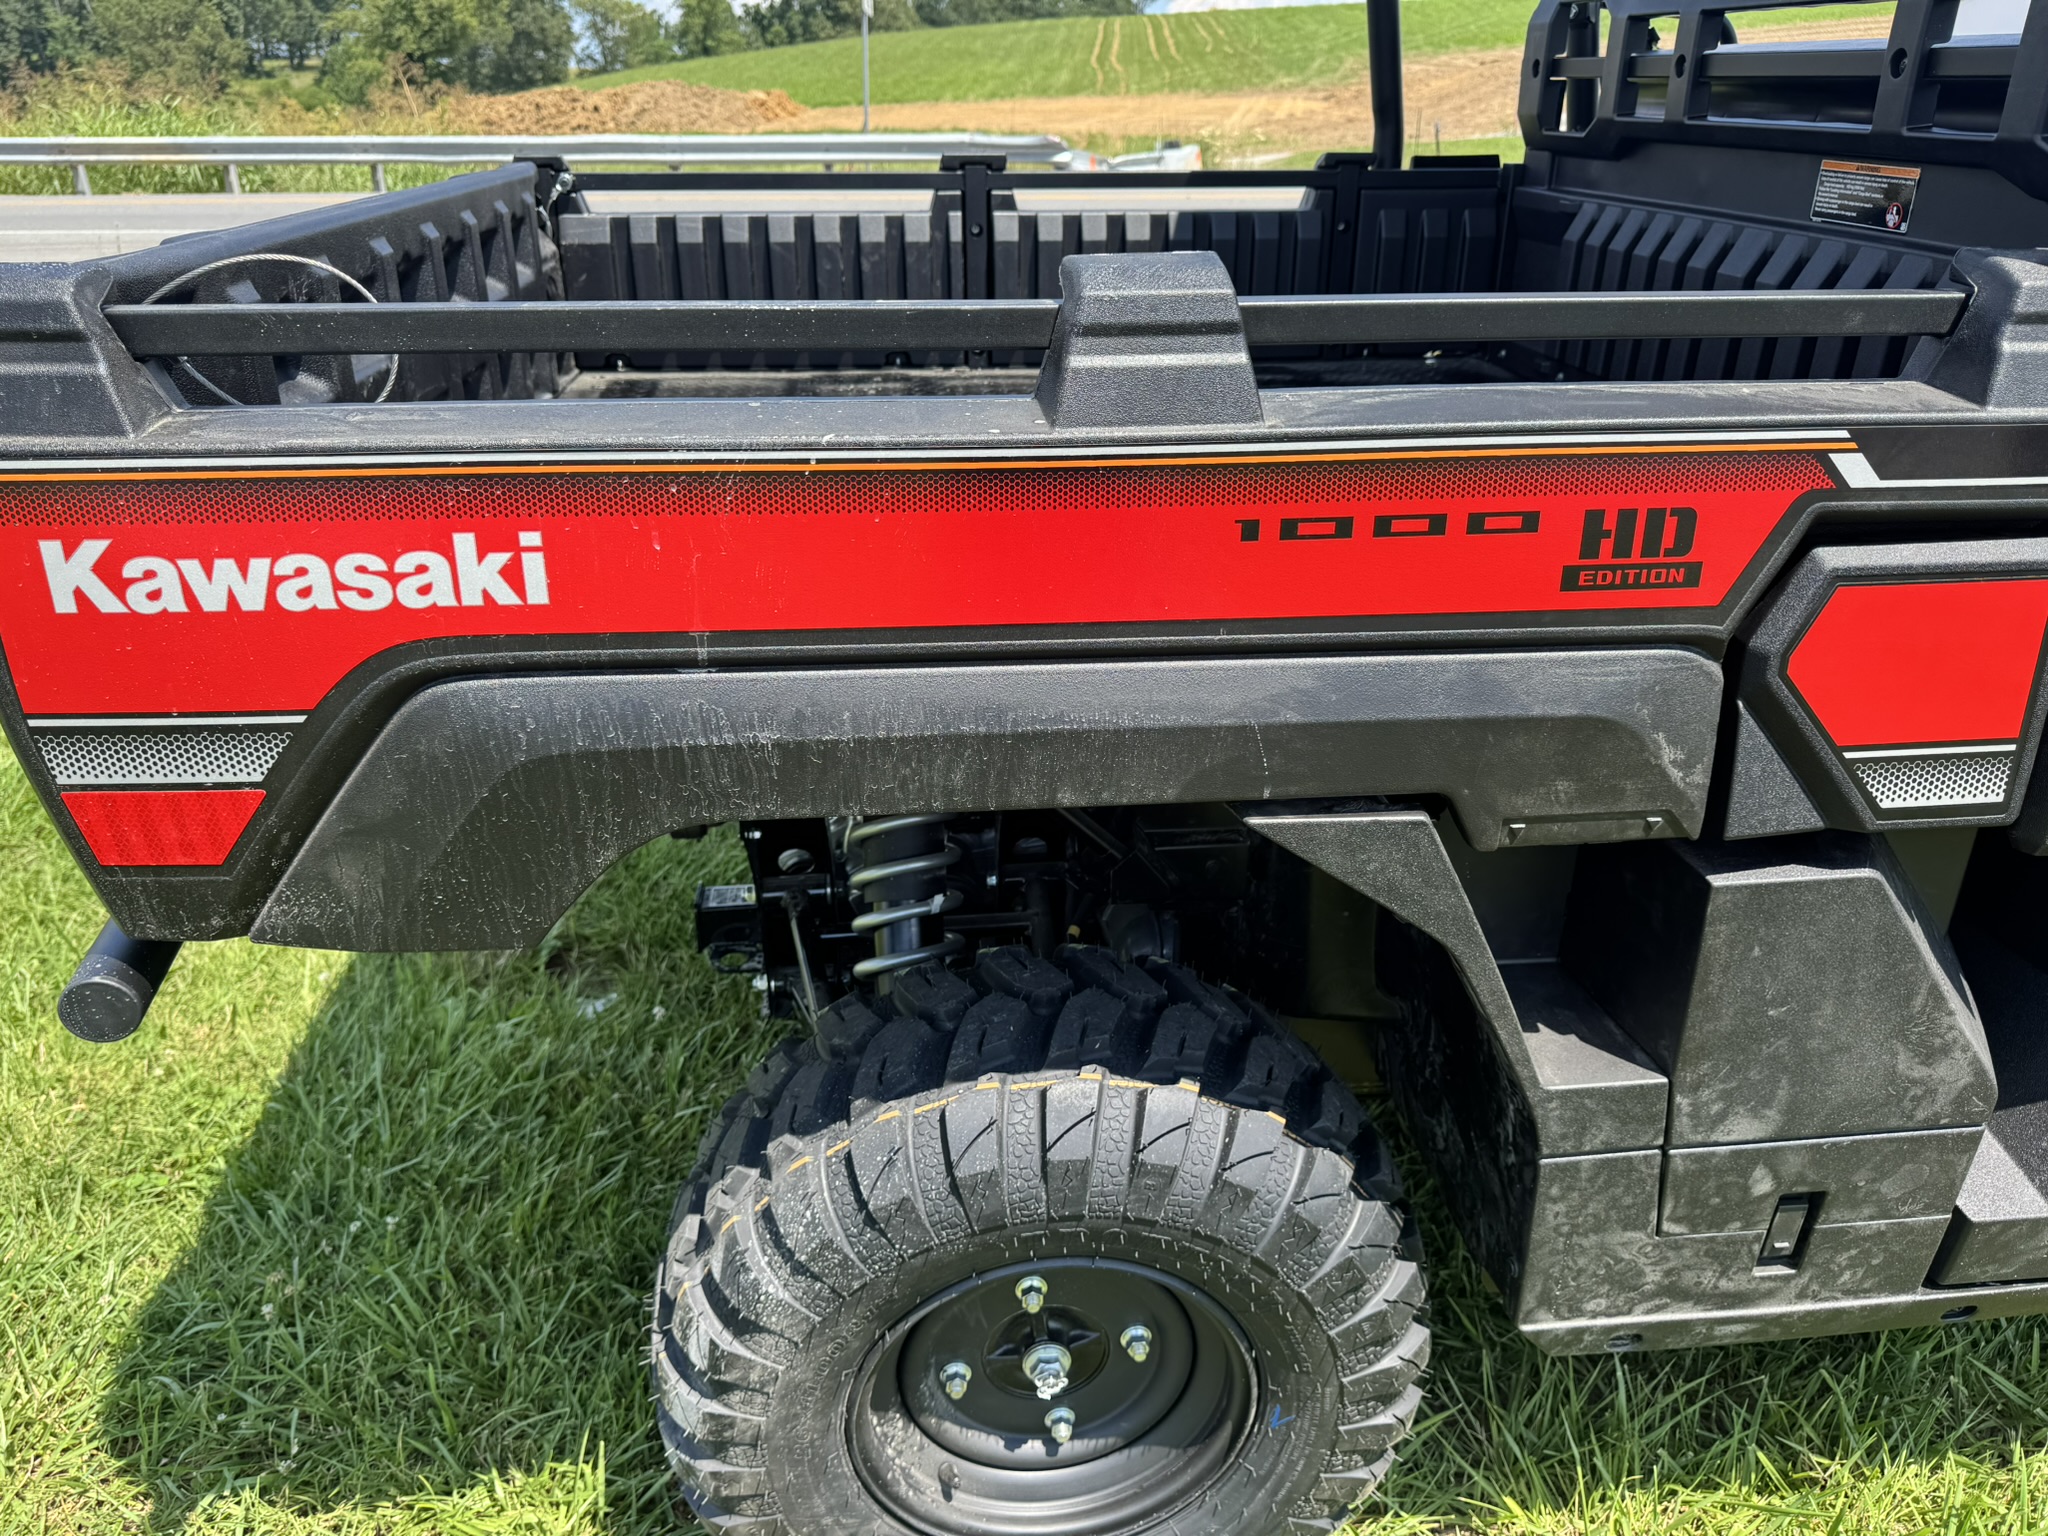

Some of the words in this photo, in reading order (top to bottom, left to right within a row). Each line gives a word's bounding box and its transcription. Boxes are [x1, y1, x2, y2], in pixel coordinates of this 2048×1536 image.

[1234, 511, 1541, 542] 1000
[1577, 507, 1698, 560] HD
[37, 531, 550, 615] Kawasaki
[1577, 566, 1685, 587] EDITION
